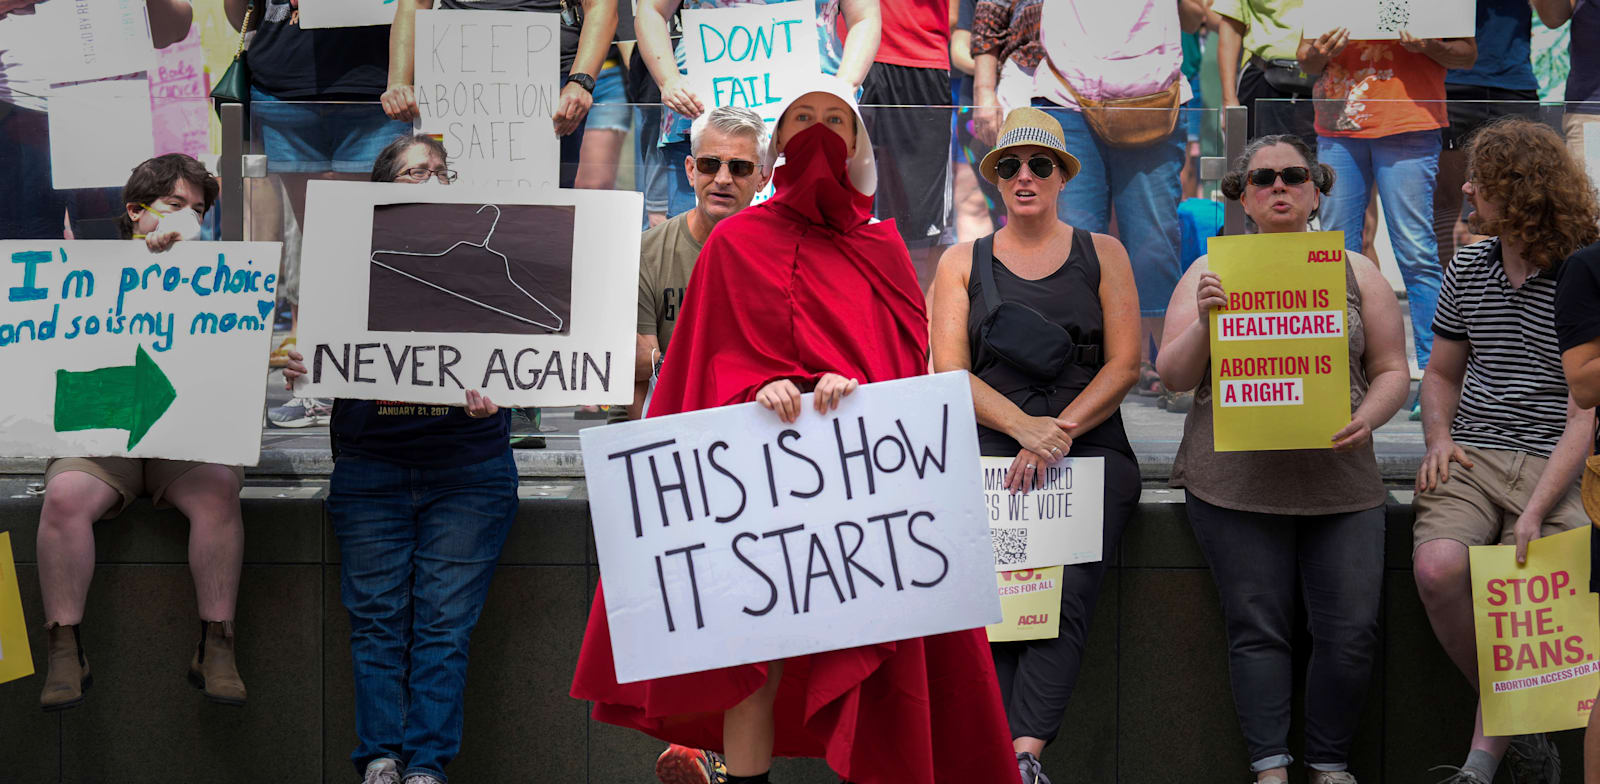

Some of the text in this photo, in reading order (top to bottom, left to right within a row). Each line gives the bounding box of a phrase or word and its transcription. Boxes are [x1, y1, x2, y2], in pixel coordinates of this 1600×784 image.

[431, 23, 553, 77] KEEP
[418, 81, 553, 119] ABORTION
[713, 72, 782, 108] FAIL
[447, 121, 526, 162] SAFE
[1307, 249, 1342, 263] ACLU
[8, 247, 276, 316] I'm pro-choice
[1312, 288, 1329, 309] IS
[0, 304, 60, 347] and
[130, 311, 174, 352] my
[1222, 314, 1341, 337] HEALTHCARE.
[313, 342, 612, 392] NEVER AGAIN
[1220, 354, 1332, 378] ABORTION IS
[1225, 381, 1299, 403] A RIGHT.
[377, 406, 415, 416] JANUARY
[431, 407, 449, 417] 2017
[607, 438, 747, 538] THIS
[763, 429, 825, 507] IS
[1008, 493, 1030, 521] WE
[1037, 492, 1073, 520] VOTE
[654, 509, 949, 633] IT STARTS
[1021, 583, 1038, 593] FOR
[1038, 580, 1054, 591] ALL
[1487, 570, 1577, 607] STOP.
[1017, 613, 1048, 626] ACLU
[1488, 606, 1564, 639] THE.
[1493, 635, 1593, 672] BANS.
[1495, 676, 1539, 693] ABORTION
[1540, 668, 1574, 686] ACCESS
[1573, 664, 1591, 677] FOR
